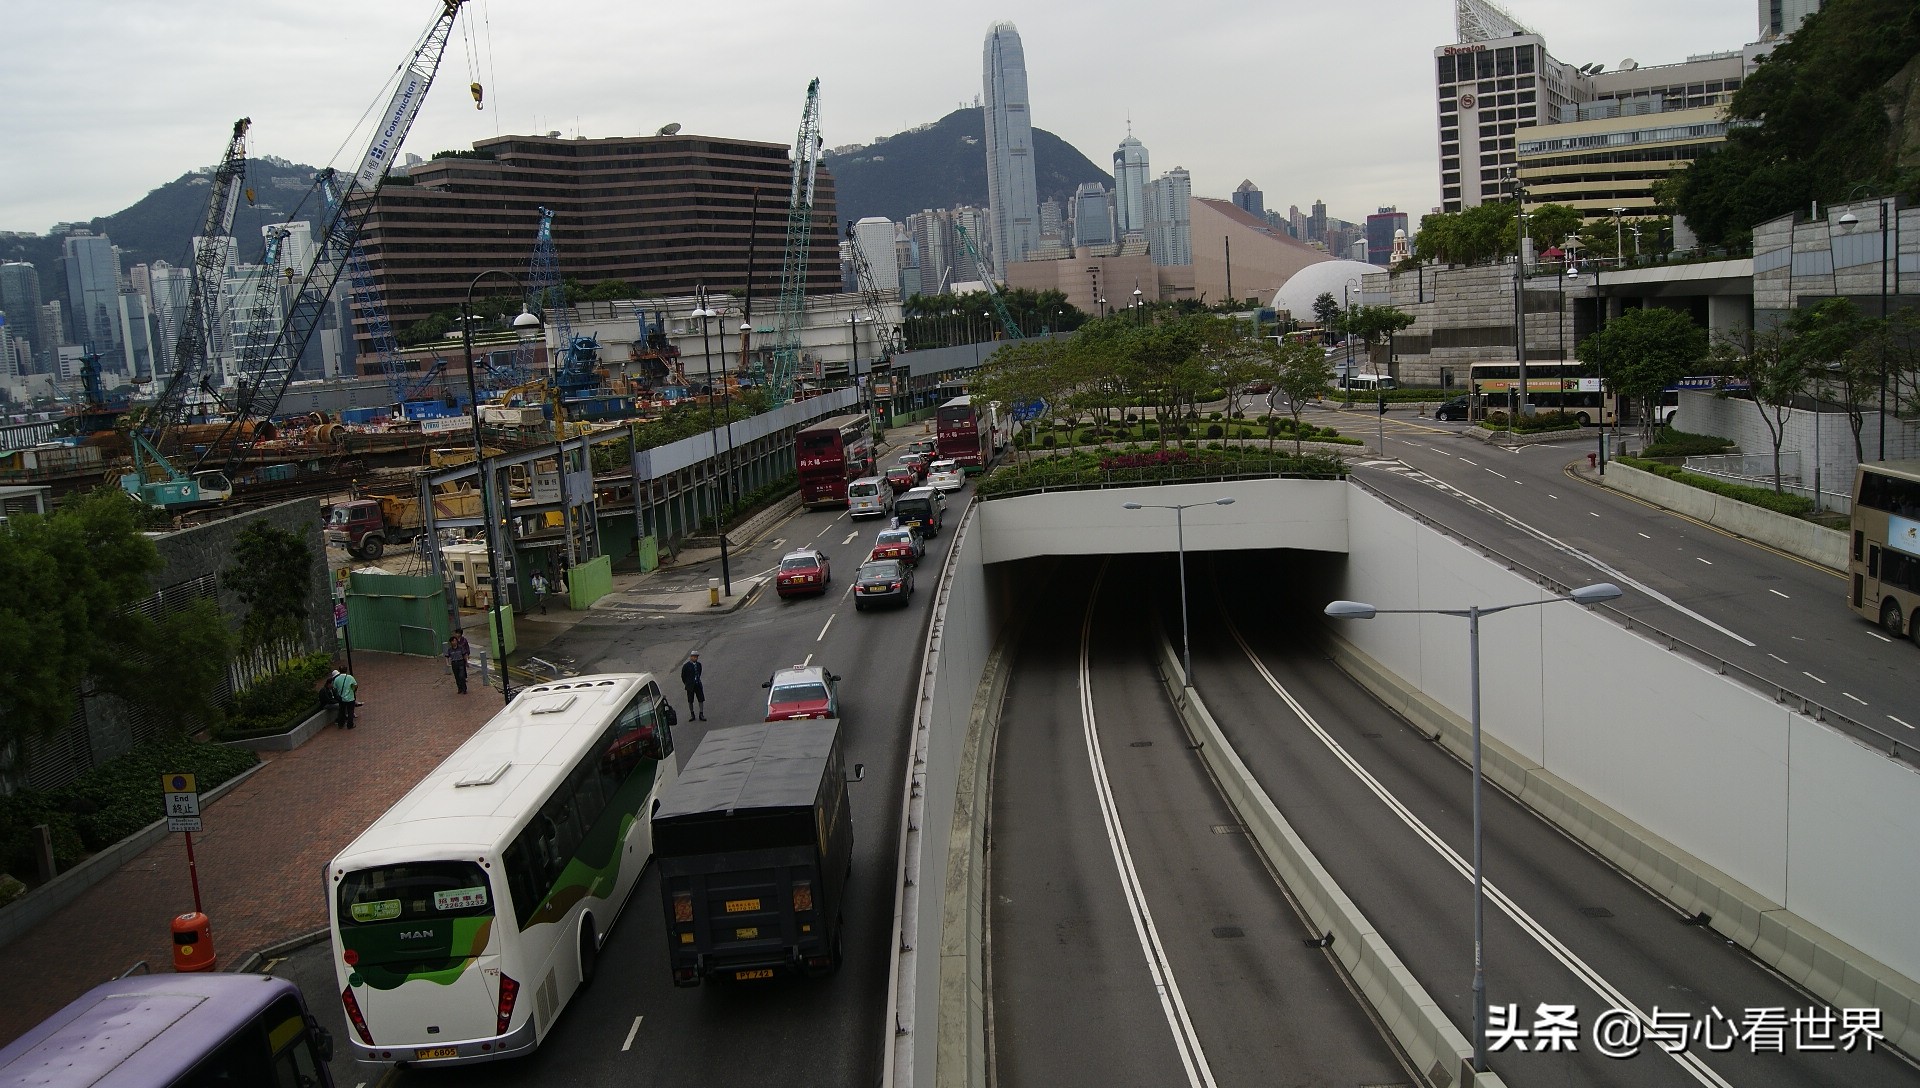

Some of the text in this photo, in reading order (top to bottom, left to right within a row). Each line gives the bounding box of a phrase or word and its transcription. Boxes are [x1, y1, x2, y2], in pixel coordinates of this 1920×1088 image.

[1444, 44, 1486, 56] Sheraton
[380, 138, 389, 149] In
[385, 80, 416, 138] Construction
[172, 803, 194, 814] 終止
[400, 929, 434, 940] MAN
[740, 970, 770, 979] PY 742
[419, 1048, 456, 1058] PT 6805
